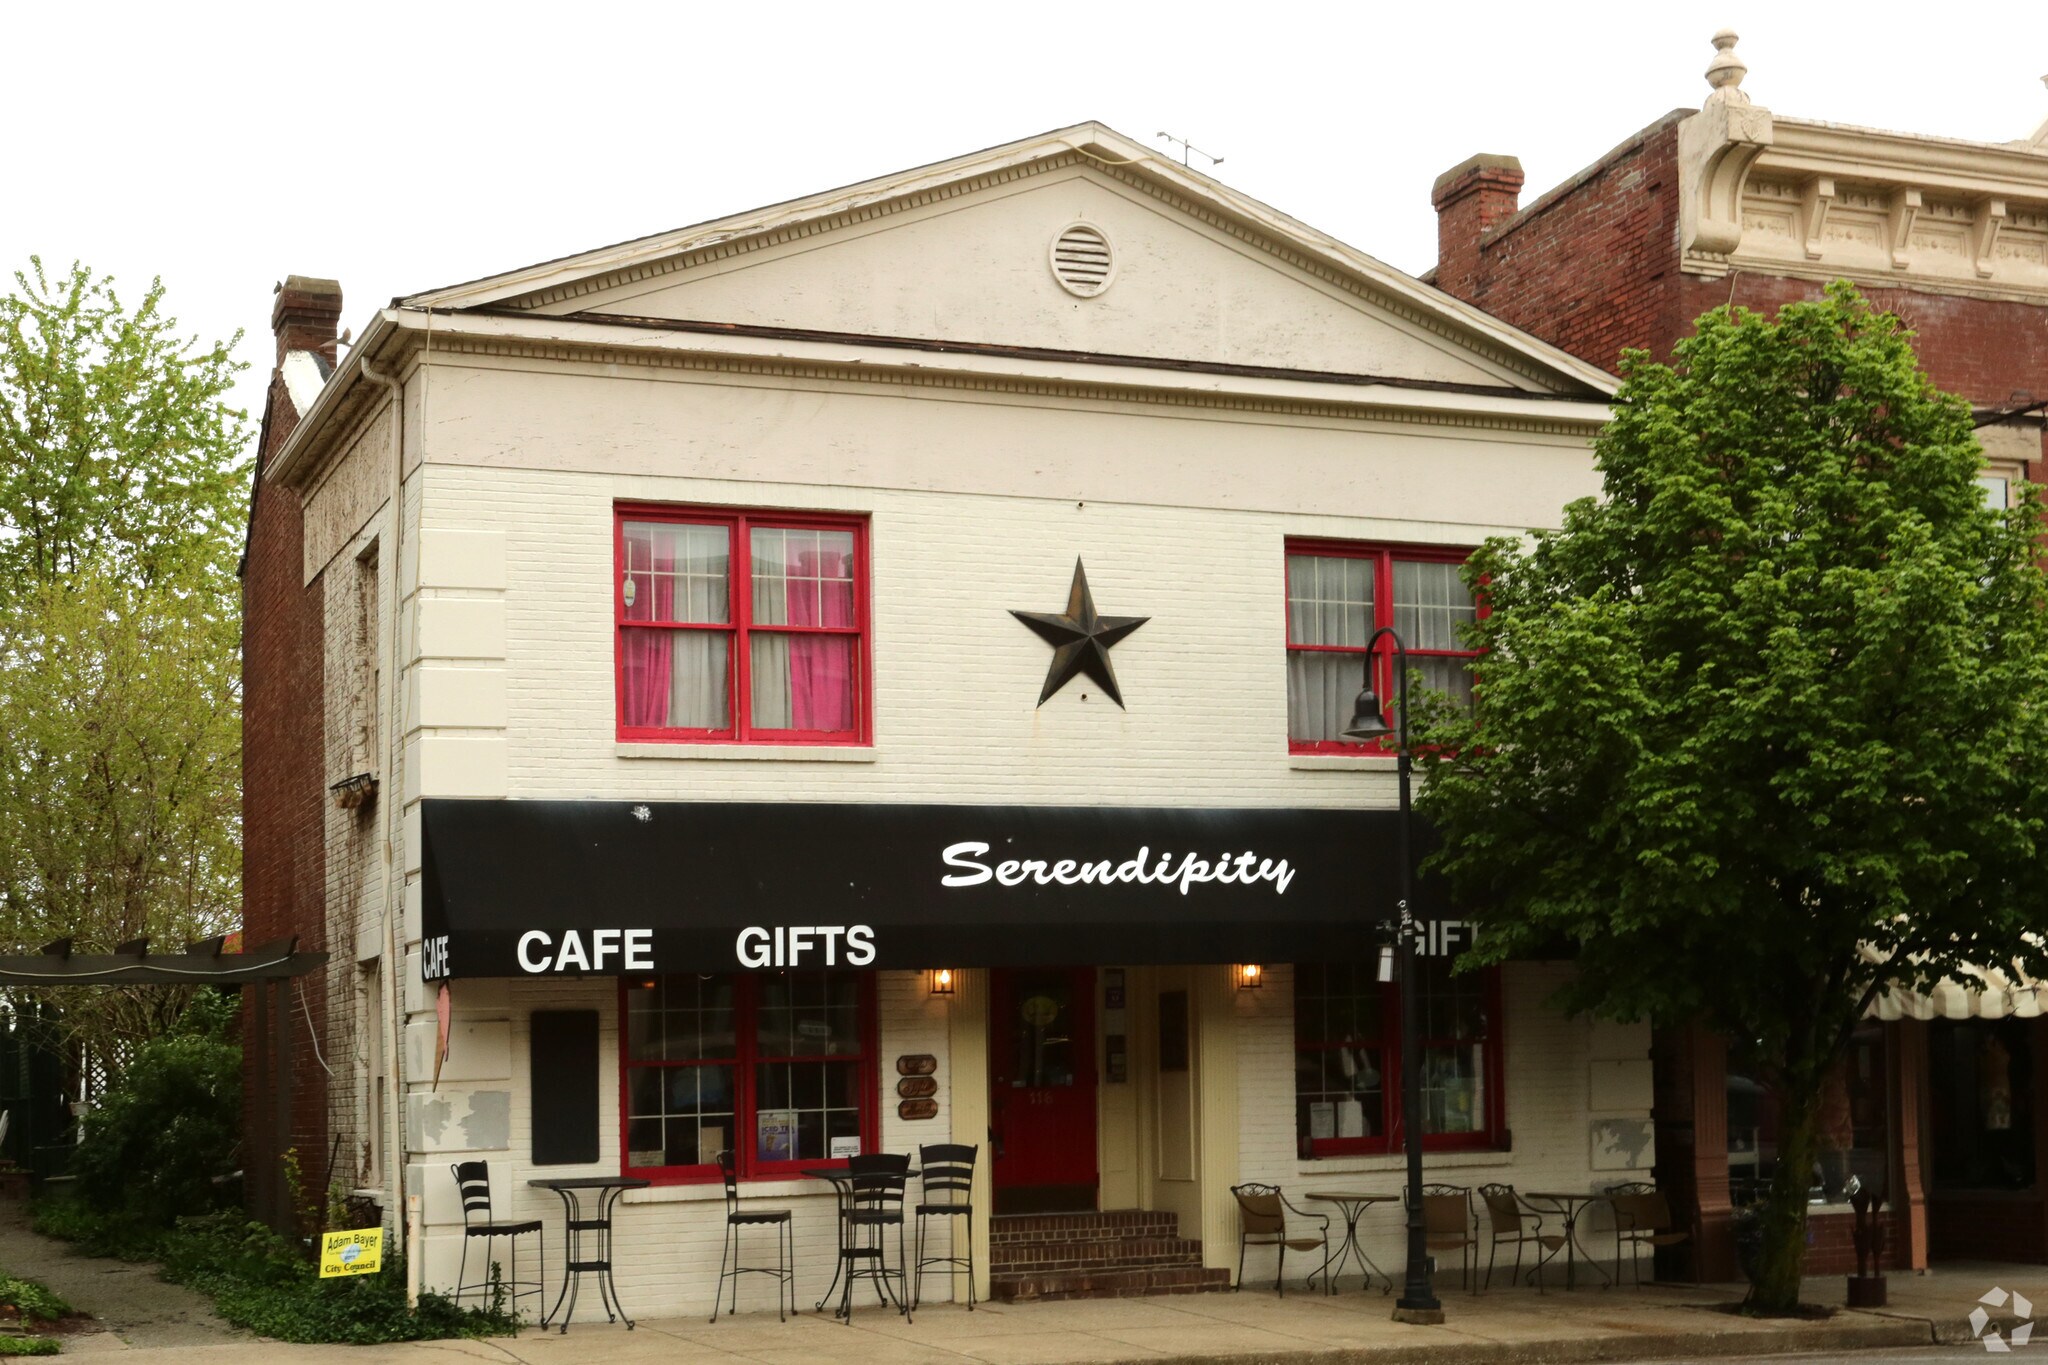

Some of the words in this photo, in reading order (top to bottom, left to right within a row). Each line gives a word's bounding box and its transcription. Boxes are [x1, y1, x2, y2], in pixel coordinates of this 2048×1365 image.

[941, 841, 1295, 895] Serendipity
[423, 935, 450, 980] CAFE
[517, 929, 655, 973] CAFE
[736, 925, 876, 968] GIFTS
[1397, 919, 1486, 956] GIFT
[327, 1236, 351, 1253] Adam
[354, 1234, 378, 1248] Bayer
[325, 1265, 342, 1273] City
[344, 1261, 376, 1271] Council
